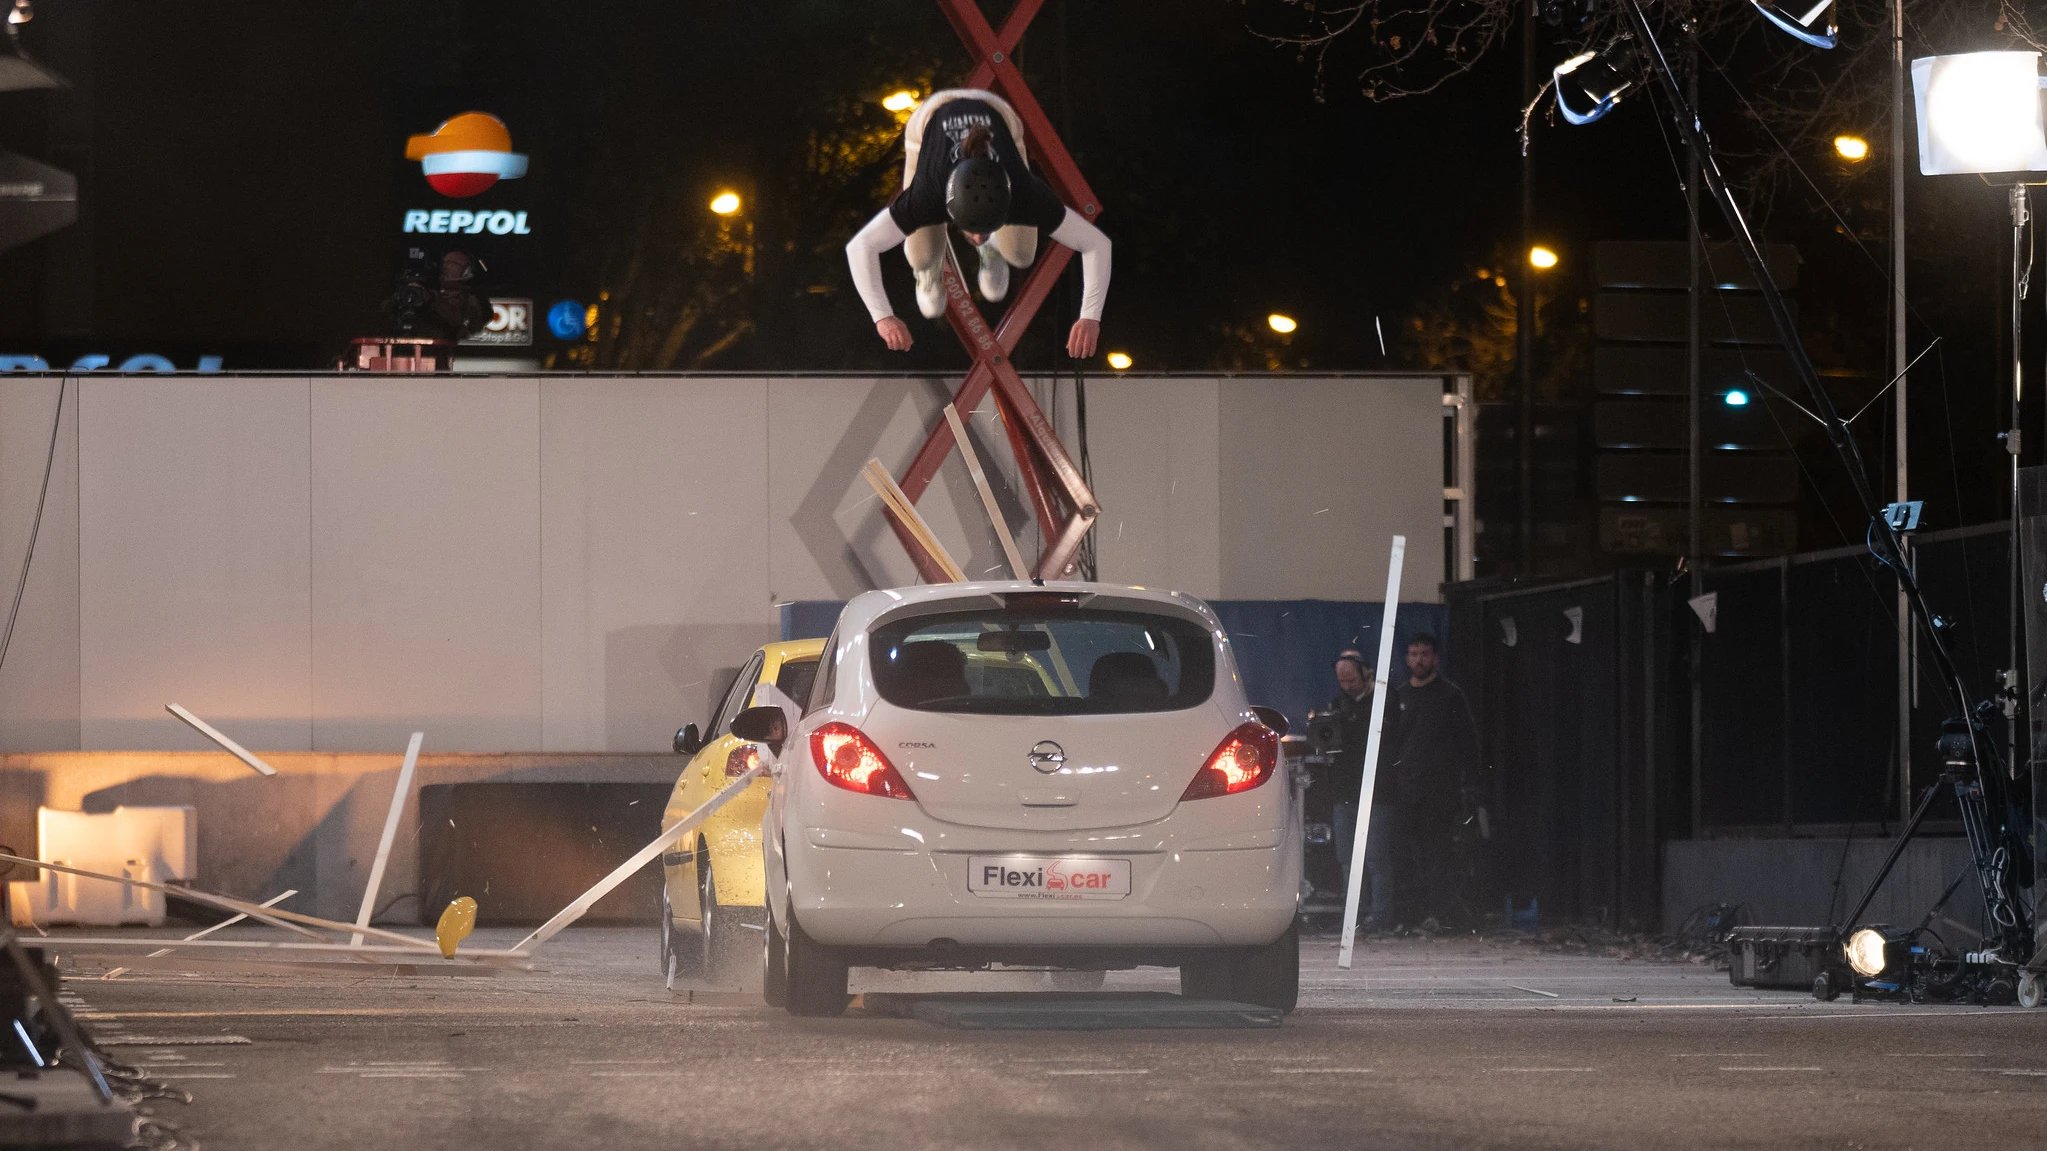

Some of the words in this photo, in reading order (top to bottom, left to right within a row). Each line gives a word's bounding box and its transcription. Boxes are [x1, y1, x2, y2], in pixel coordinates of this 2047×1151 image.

[403, 209, 531, 235] REPSOL
[946, 276, 963, 300] 900
[959, 301, 974, 318] 92
[485, 304, 527, 331] OR
